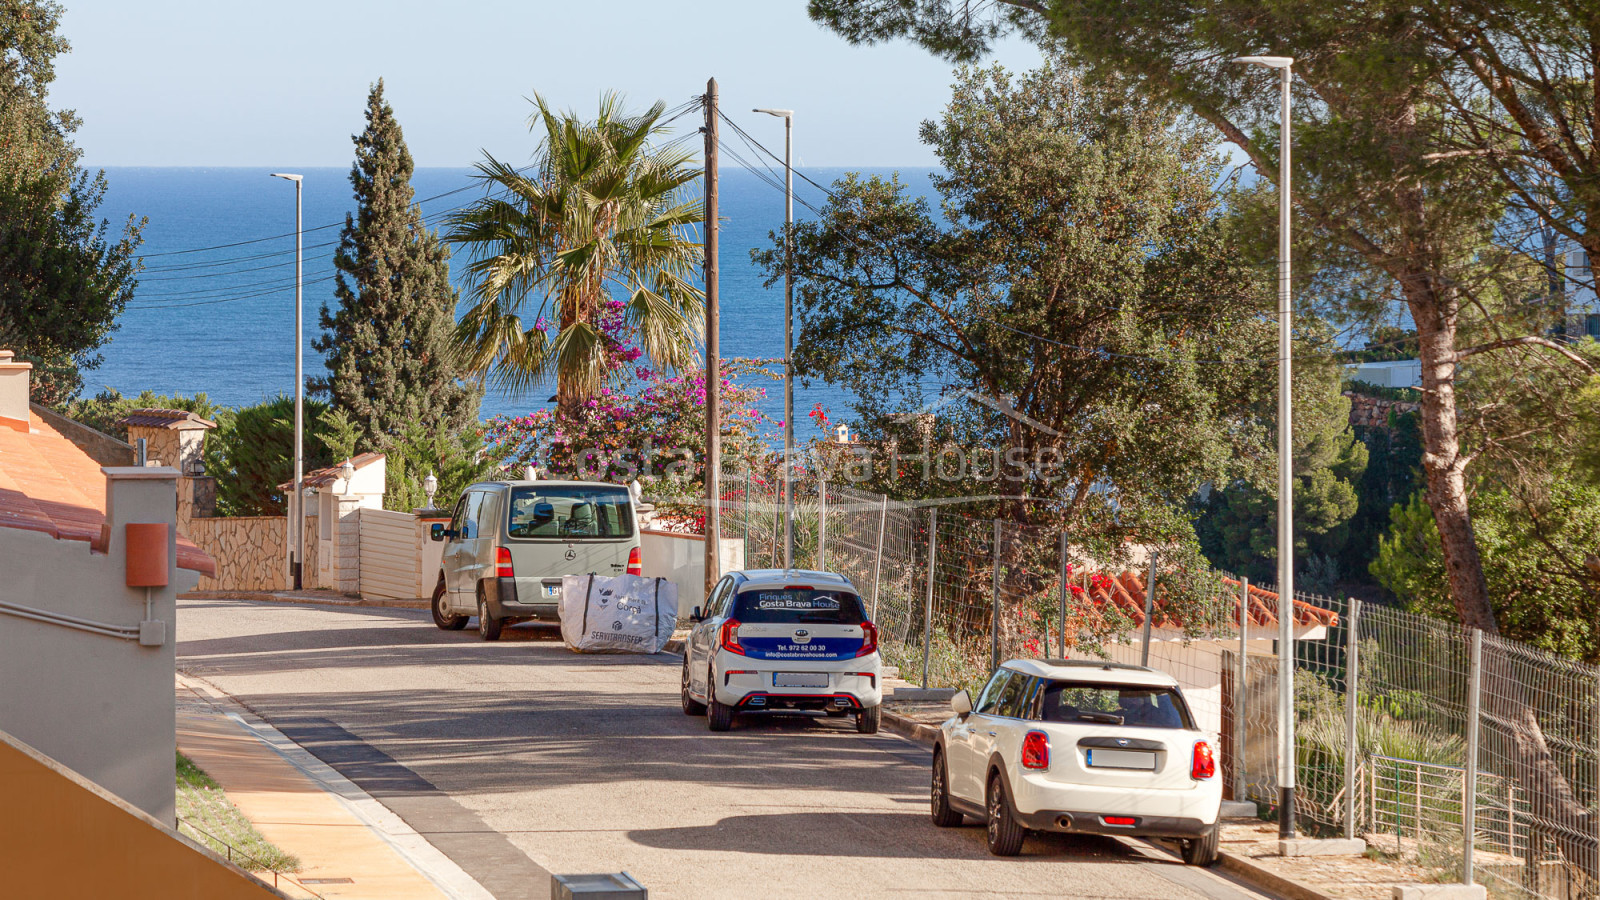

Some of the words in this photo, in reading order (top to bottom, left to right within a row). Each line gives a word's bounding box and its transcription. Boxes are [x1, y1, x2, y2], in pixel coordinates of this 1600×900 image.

[759, 593, 793, 602] Finques
[759, 600, 785, 608] Costa
[786, 600, 812, 608] Brava
[812, 600, 840, 609] House
[591, 631, 643, 645] SERVITRANSFER
